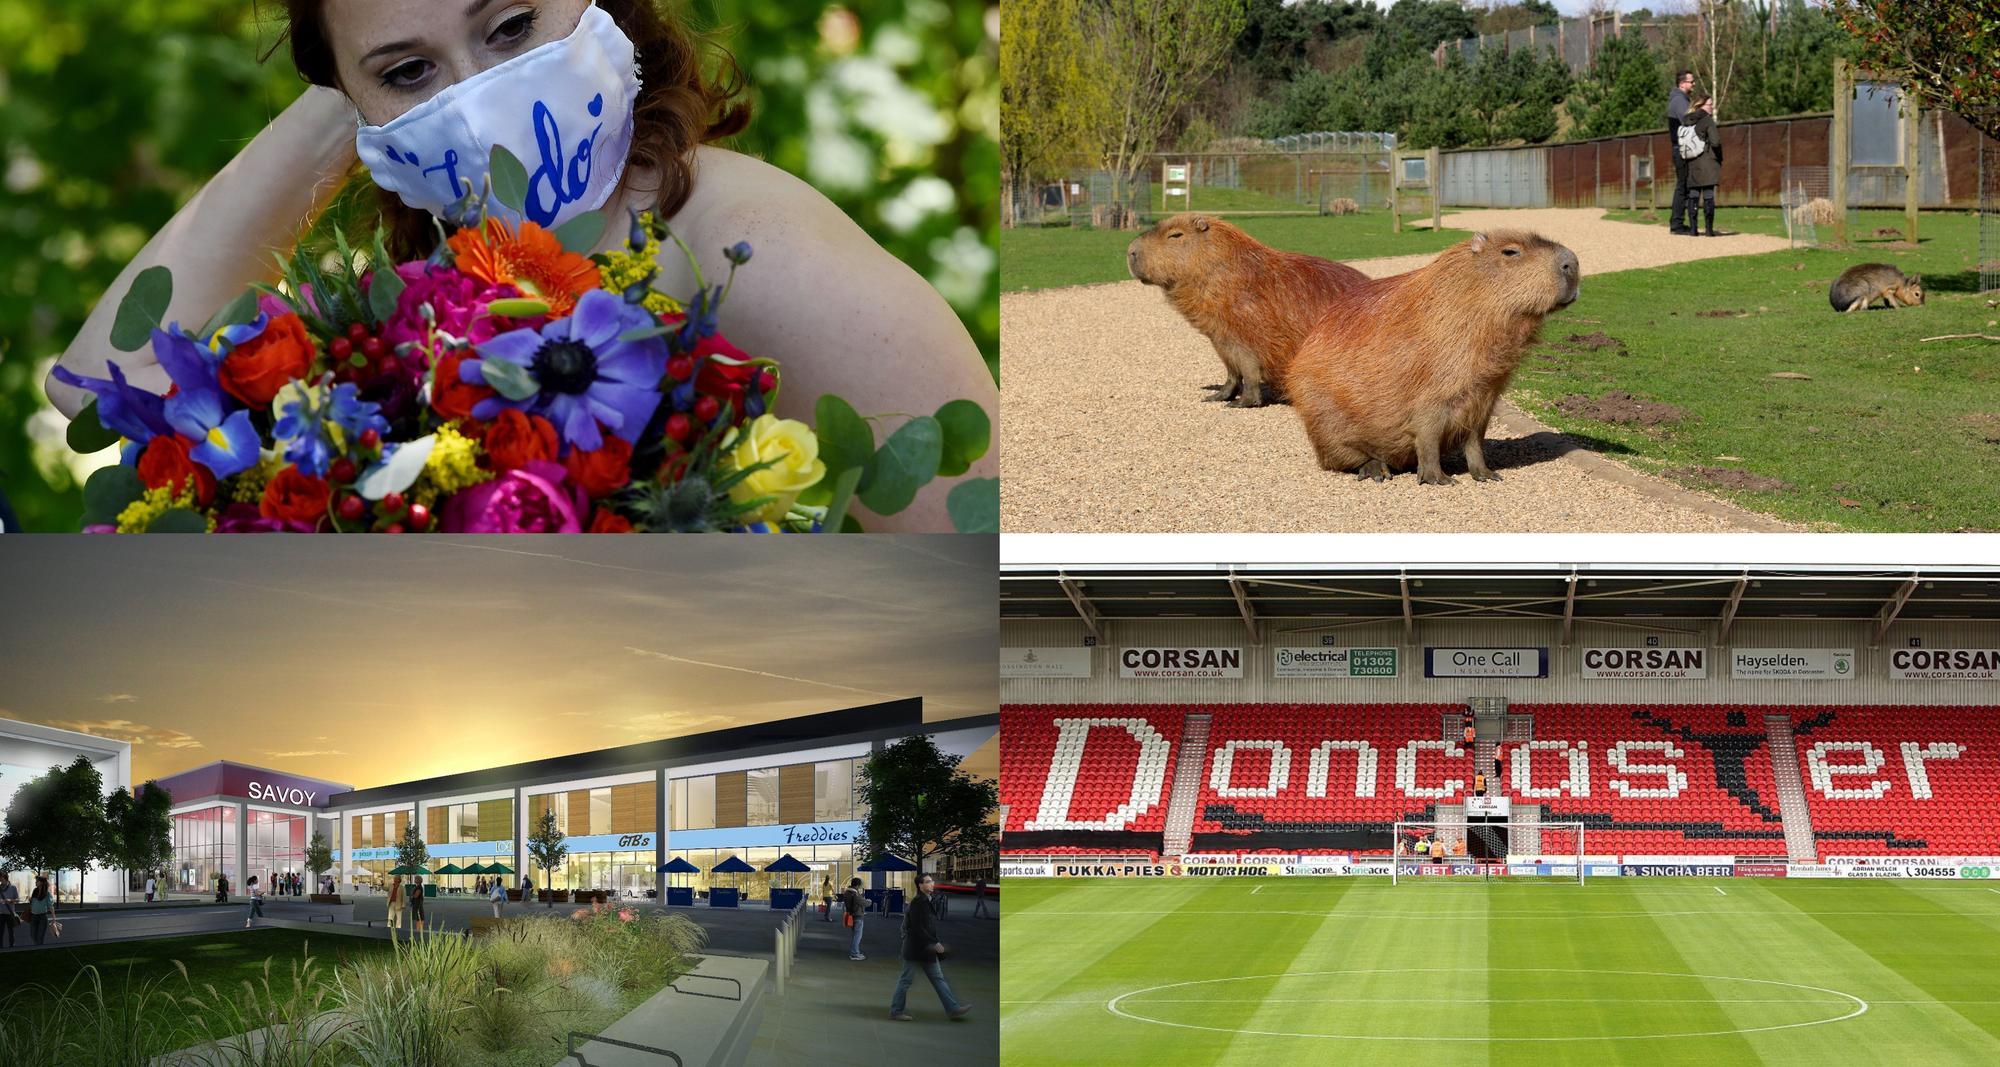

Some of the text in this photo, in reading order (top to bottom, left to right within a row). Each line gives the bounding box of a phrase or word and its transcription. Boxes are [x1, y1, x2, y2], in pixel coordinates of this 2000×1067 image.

[525, 101, 603, 228] do
[1123, 650, 1240, 669] CORSAN
[1294, 650, 1347, 662] electrical
[1452, 651, 1520, 666] One Call
[1585, 650, 1702, 669] CORSAN
[1354, 658, 1392, 666] 01302
[1135, 669, 1223, 677] www.corsan.co.uk
[1597, 669, 1686, 678] www.corsan.co.uk
[248, 781, 316, 806] SAVOY
[783, 825, 848, 844] Freddies
[1057, 865, 1164, 876] PUKKA-PIES
[1285, 865, 1333, 875] Stoneacre
[1342, 865, 1389, 875] Stoneacre
[1397, 864, 1449, 876] sky BET
[1454, 866, 1475, 876] sky
[1641, 866, 1693, 877] SINGHA
[1696, 866, 1730, 877] BEER
[1914, 867, 1956, 877] 304555
